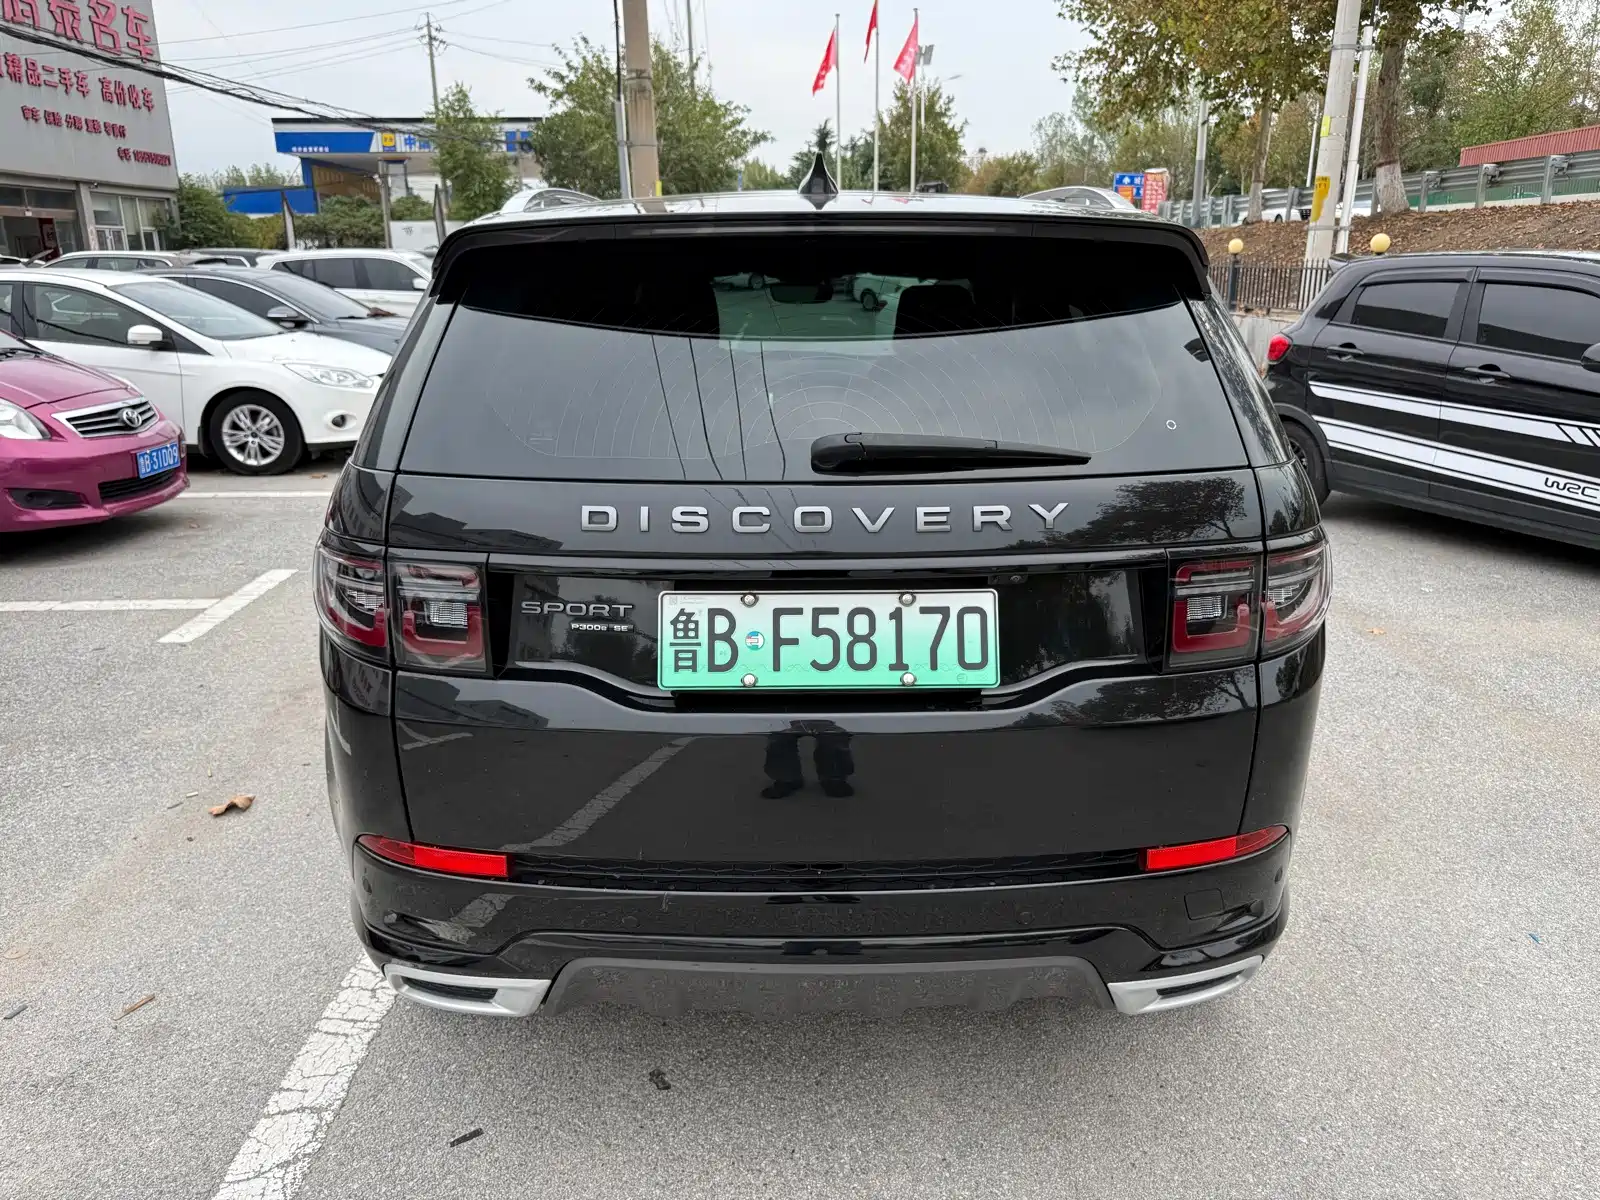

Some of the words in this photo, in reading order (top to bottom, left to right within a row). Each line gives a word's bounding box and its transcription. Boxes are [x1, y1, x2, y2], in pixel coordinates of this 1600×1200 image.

[98, 76, 154, 112] 高价收车
[1544, 477, 1600, 499] WRC
[581, 502, 1069, 533] DISCOVERY
[521, 601, 633, 617] SPORT
[571, 623, 608, 631] P300e
